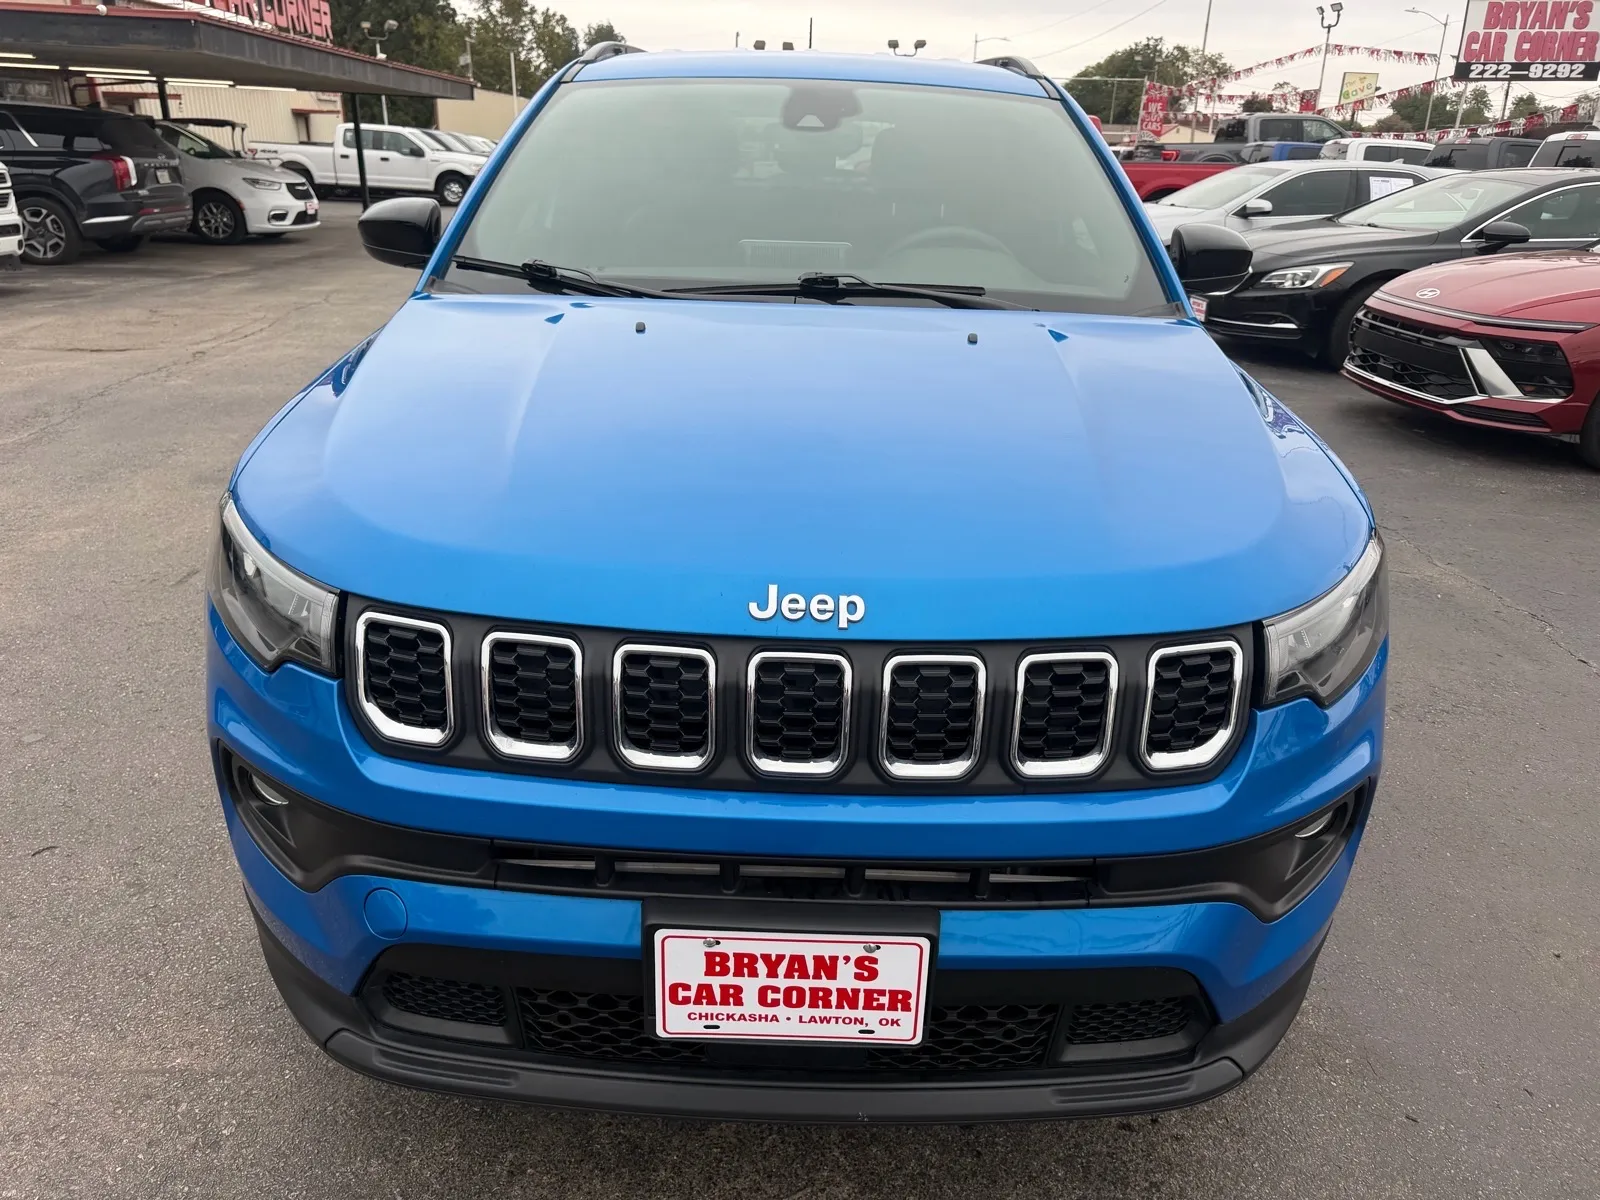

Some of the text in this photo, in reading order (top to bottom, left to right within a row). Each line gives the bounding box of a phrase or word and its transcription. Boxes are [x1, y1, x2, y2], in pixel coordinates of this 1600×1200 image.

[262, 0, 334, 40] CORNER
[1483, 1, 1594, 30] BRYAN'S
[1463, 31, 1600, 62] CAR CORNER
[1148, 102, 1163, 112] WE
[1142, 121, 1162, 131] CARS
[748, 584, 866, 630] Jeep
[704, 951, 879, 982] BRYAN'S
[668, 982, 913, 1012] CAR CORNER
[687, 1011, 902, 1028] CHICKASHA LAWTON, OK
